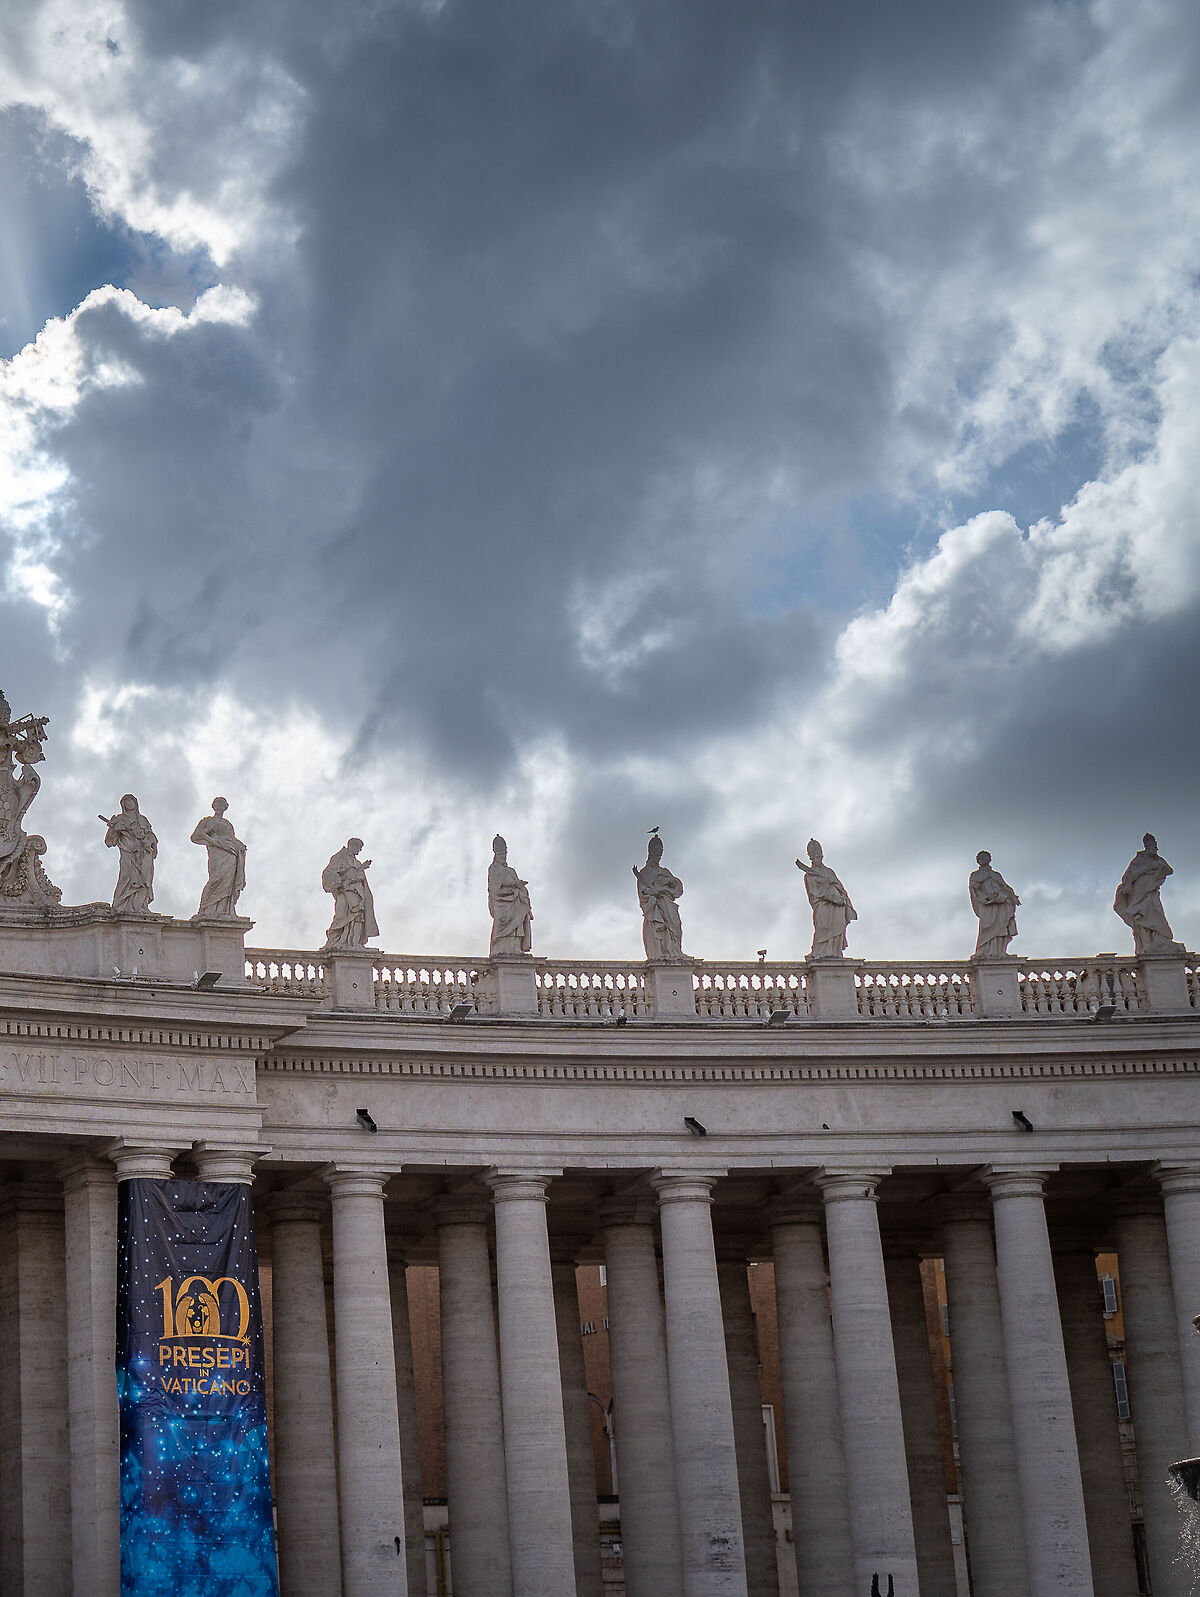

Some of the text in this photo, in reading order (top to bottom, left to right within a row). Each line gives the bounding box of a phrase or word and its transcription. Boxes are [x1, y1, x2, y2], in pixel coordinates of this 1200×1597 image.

[11, 1052, 60, 1083] VII
[71, 1056, 163, 1089] PONT
[177, 1062, 253, 1094] MAX
[154, 1275, 251, 1341] 100
[159, 1345, 250, 1369] PRESEPI
[199, 1368, 210, 1378] IN
[160, 1377, 251, 1396] VATICANO
